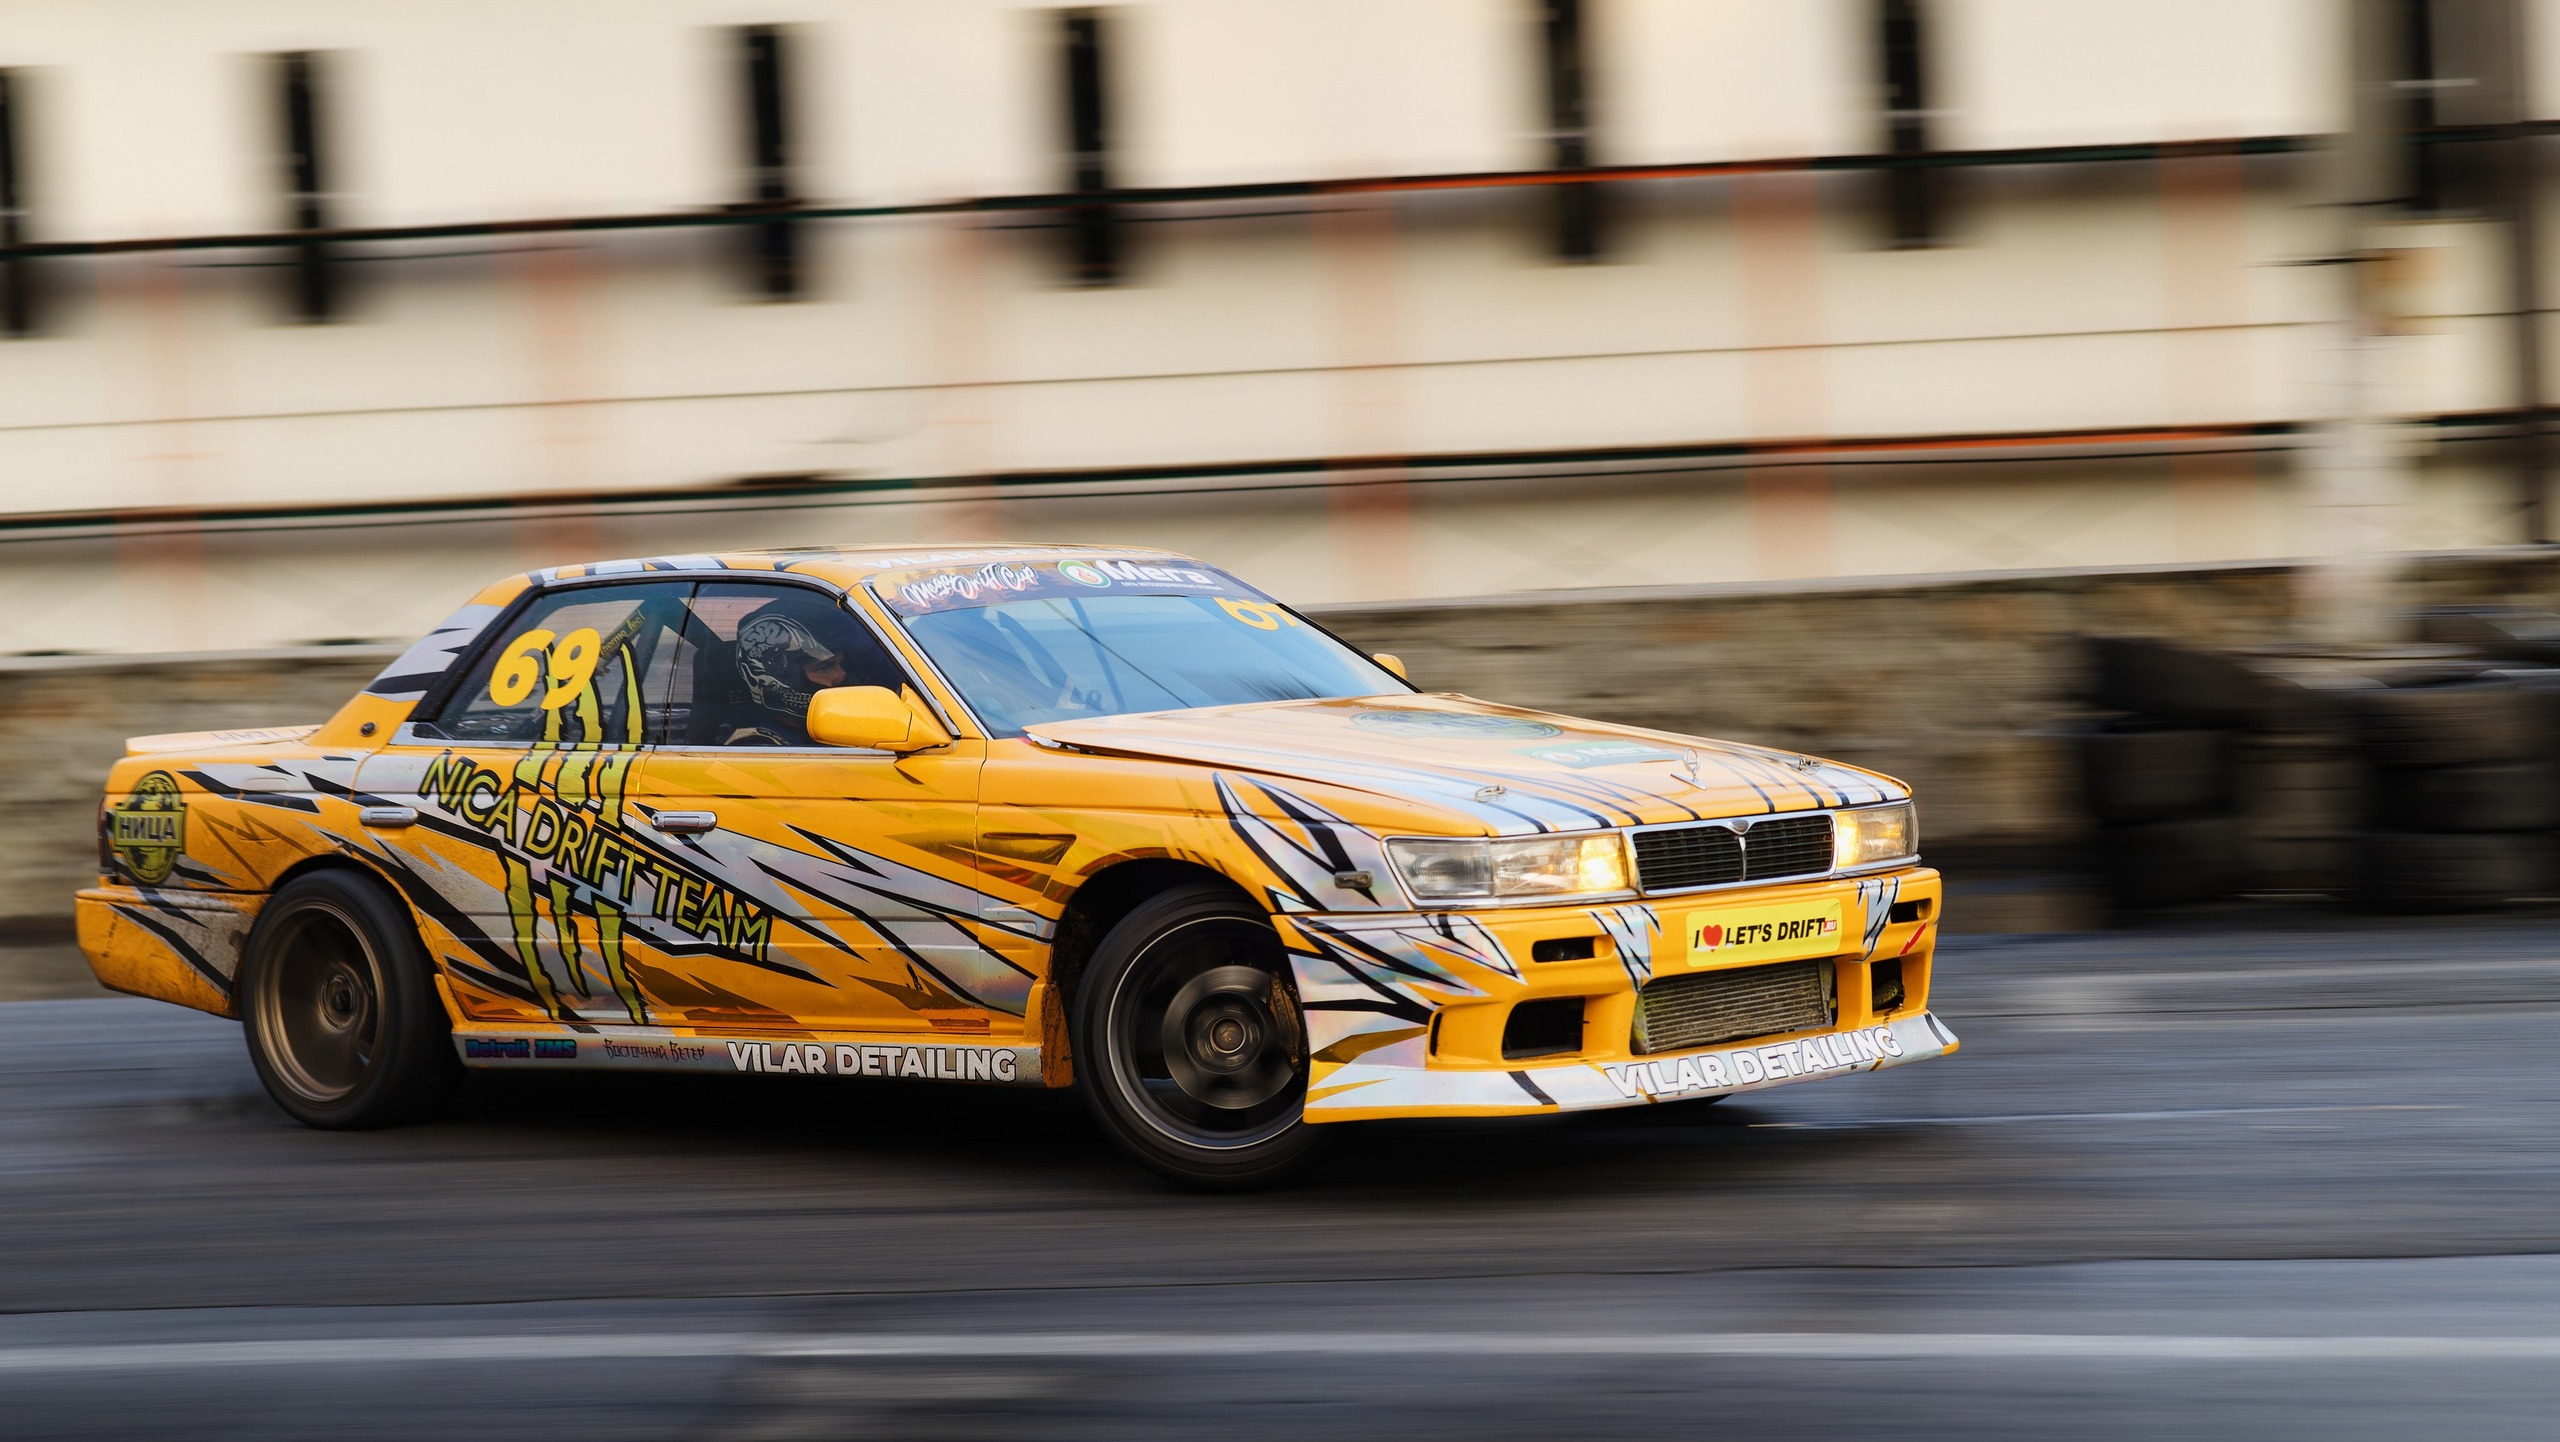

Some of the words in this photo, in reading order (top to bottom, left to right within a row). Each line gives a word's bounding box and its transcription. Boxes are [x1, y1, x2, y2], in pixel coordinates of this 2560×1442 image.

[862, 551, 982, 570] VILAR
[900, 573, 954, 608] Mega
[953, 562, 1003, 600] Drift
[1000, 562, 1039, 592] Cup
[490, 627, 601, 710] 69
[118, 815, 177, 844] НИЦА
[420, 751, 518, 848] NICA
[522, 797, 645, 903] DRIFT
[653, 862, 772, 962] TEAM
[1694, 929, 1701, 948] I
[1725, 923, 1773, 946] LET'S
[465, 1038, 530, 1058] Detroit
[534, 1038, 577, 1058] ZMS
[726, 1041, 828, 1075] VILAR
[835, 1045, 1017, 1082] DETAILING
[1604, 1054, 1733, 1098] VILAR
[1731, 1027, 1904, 1085] DETAILING
